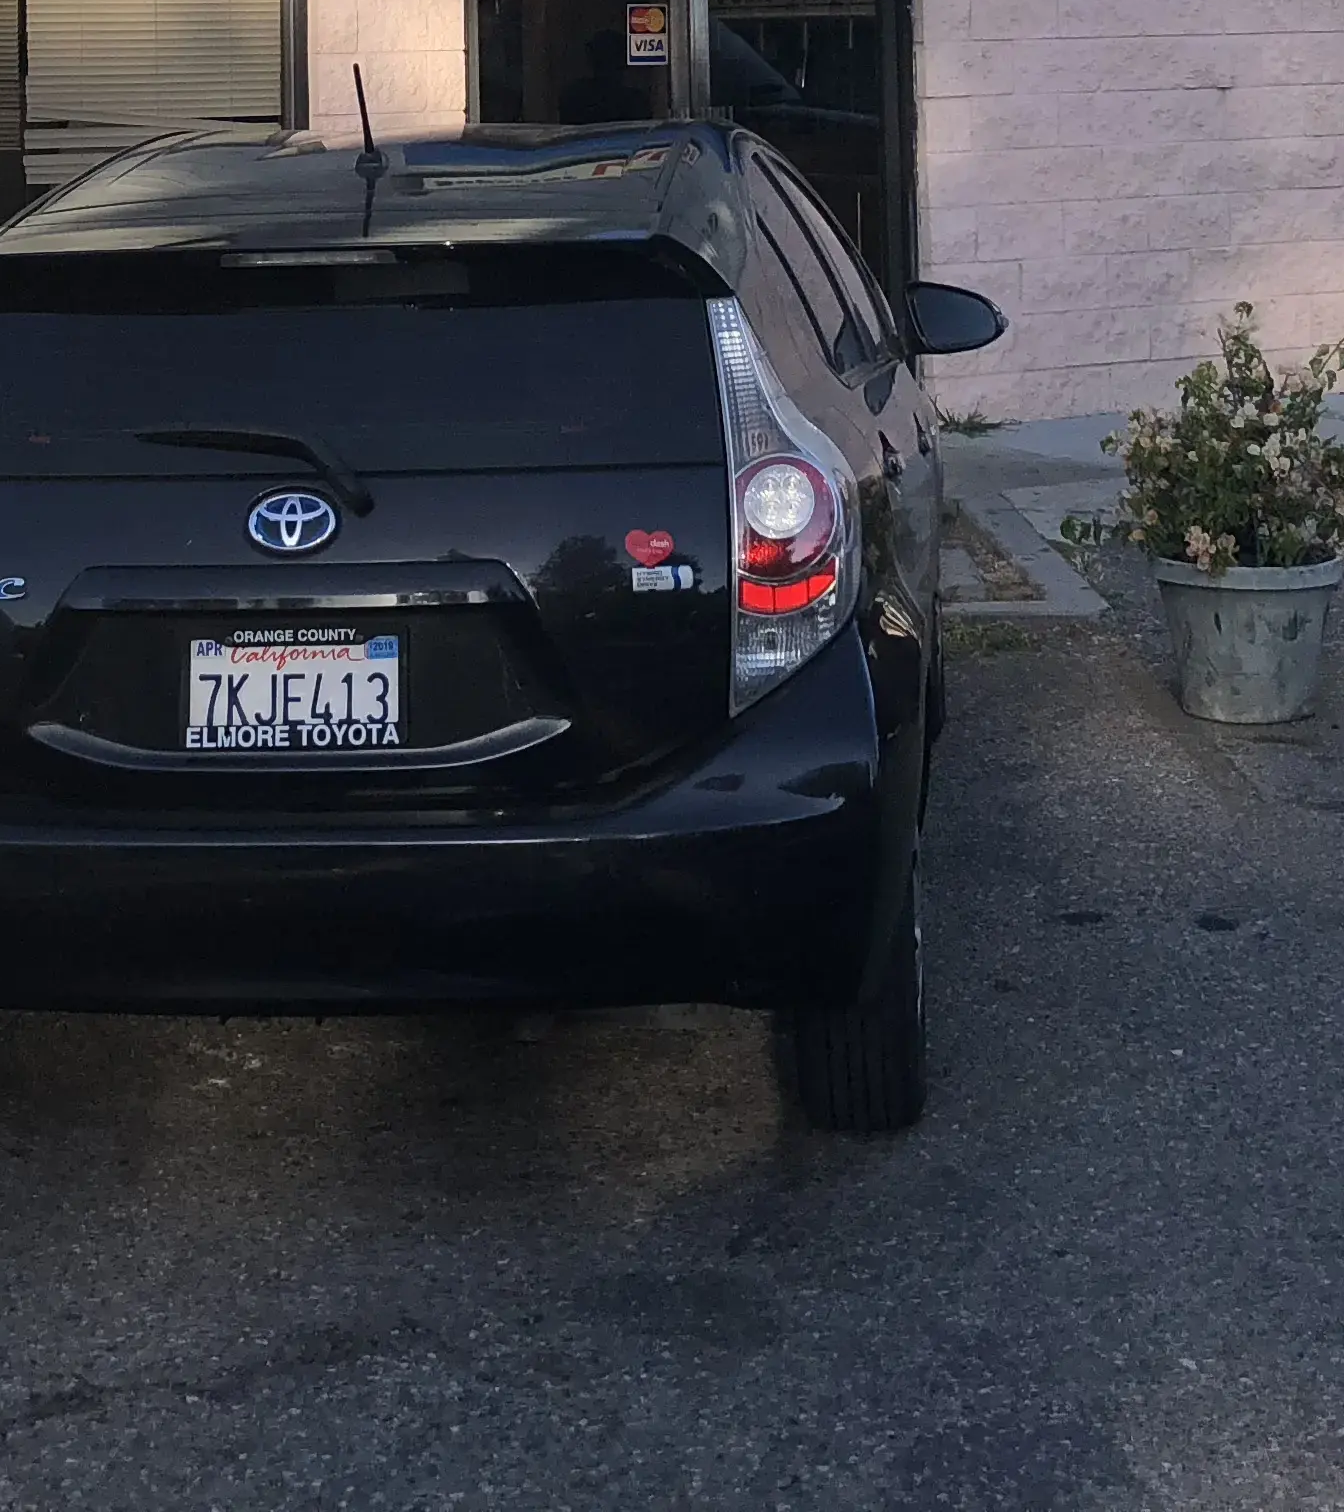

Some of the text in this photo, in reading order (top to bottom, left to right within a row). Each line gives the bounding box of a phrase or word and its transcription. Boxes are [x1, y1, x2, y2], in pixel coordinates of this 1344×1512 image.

[635, 39, 664, 51] VISA
[233, 628, 356, 643] ORANGE COUNTY
[197, 642, 222, 656] APR
[230, 645, 365, 670] California
[198, 672, 390, 726] 7KJE413
[186, 723, 400, 748] ELMORE TOYOTA
